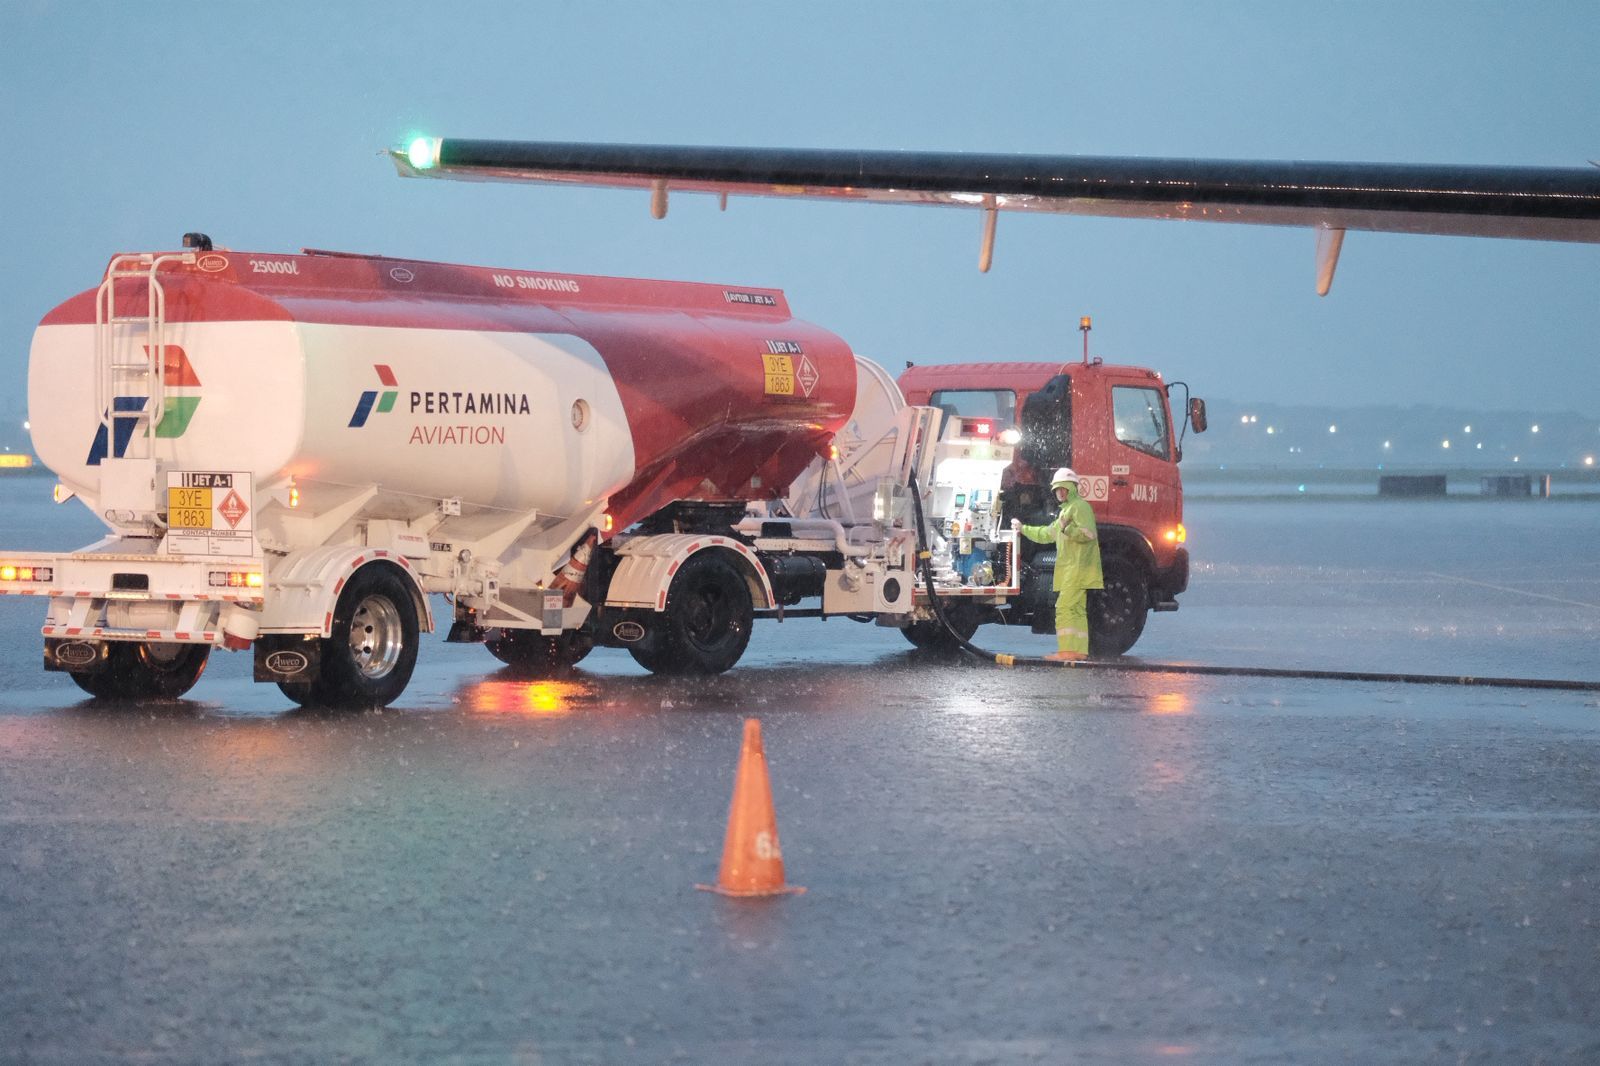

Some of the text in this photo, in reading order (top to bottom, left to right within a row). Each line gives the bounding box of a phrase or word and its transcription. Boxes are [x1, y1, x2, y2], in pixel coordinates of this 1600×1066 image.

[492, 274, 580, 293] NO SMOKING
[775, 341, 788, 353] JET
[769, 356, 787, 373] 3YE
[770, 376, 791, 393] 1863
[410, 391, 531, 415] PERTAMINA
[408, 426, 505, 445] AVIATION
[193, 474, 232, 487] JET A-1
[179, 490, 203, 507] 3YE
[1131, 484, 1158, 503] JUA 31
[177, 510, 206, 527] 1863
[271, 655, 302, 668] Aweco
